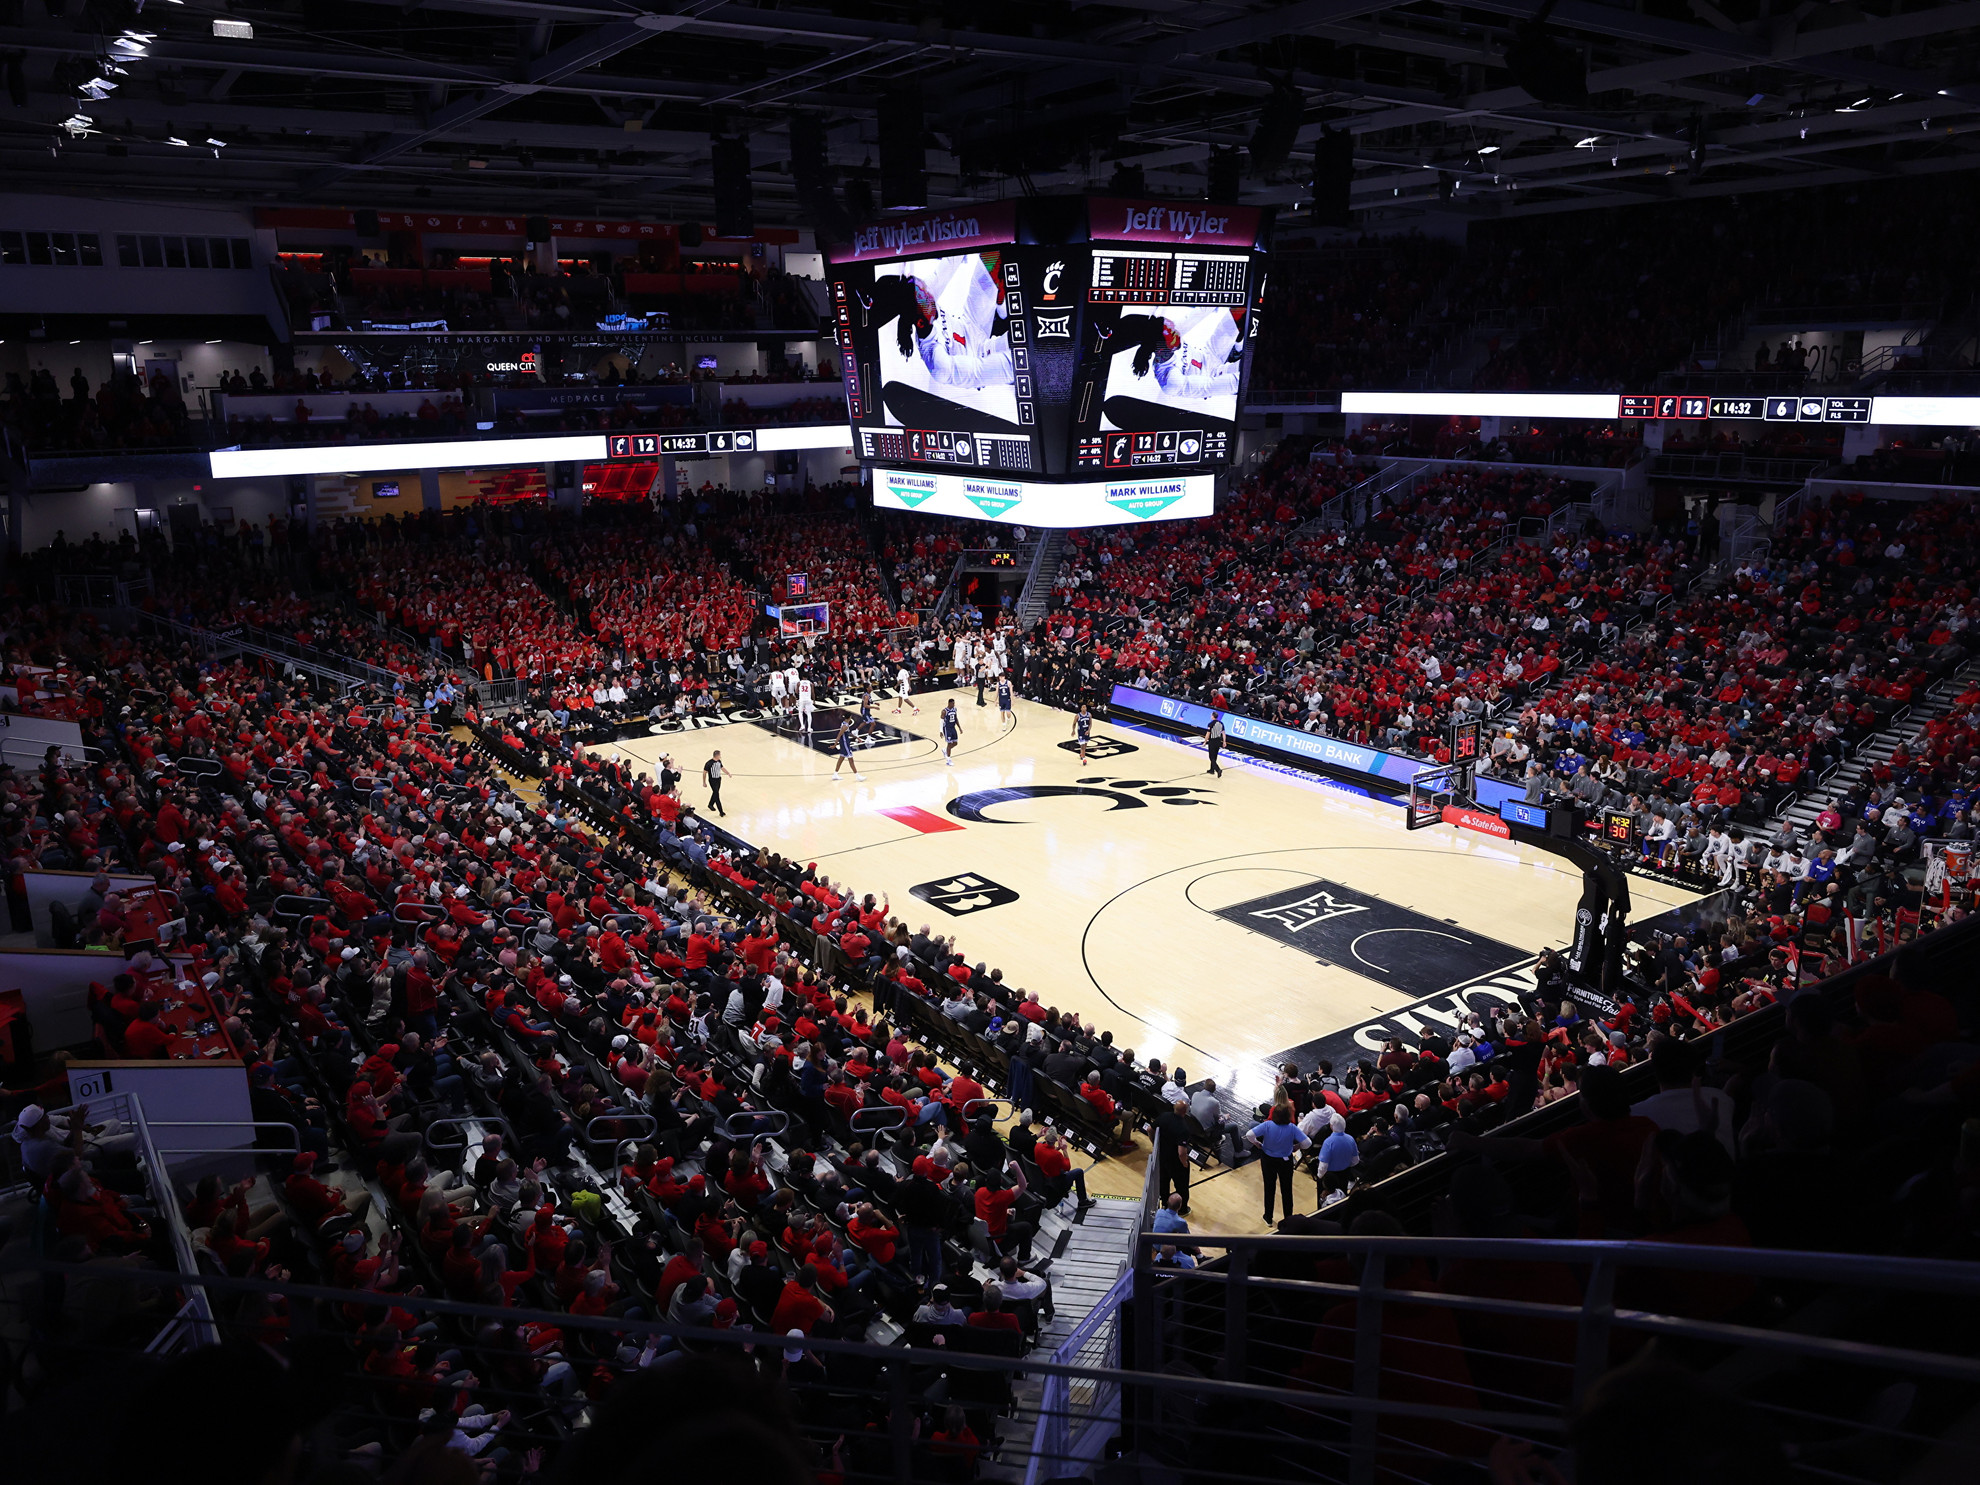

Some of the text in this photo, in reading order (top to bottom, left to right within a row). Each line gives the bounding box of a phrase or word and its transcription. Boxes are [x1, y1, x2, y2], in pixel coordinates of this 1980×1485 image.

[1123, 207, 1228, 240] Jeff Wyler
[854, 226, 880, 256] Jeff
[487, 363, 517, 371] QUEEN
[551, 394, 605, 403] MEDPACE
[1685, 401, 1702, 415] 12
[1723, 402, 1751, 414] 14:32
[1776, 402, 1786, 416] 6
[638, 439, 654, 452] 12
[672, 438, 696, 449] 14:32
[716, 436, 725, 448] 6
[926, 434, 936, 446] 12
[943, 435, 949, 446] 6
[1139, 437, 1151, 448] 12
[1163, 436, 1170, 447] 6
[889, 477, 934, 488] MARK WILLIAMS
[966, 484, 1018, 497] MARK WILLIAMS
[1110, 484, 1181, 497] MARK WILLIAMS
[792, 583, 804, 594] 30
[1251, 725, 1282, 743] FIFTH
[1286, 735, 1322, 754] THIRD
[1325, 745, 1363, 764] BANK
[1458, 737, 1474, 757] 30
[1612, 816, 1630, 828] 14:32
[1612, 826, 1626, 838] 30
[1956, 857, 1965, 865] G
[1567, 984, 1604, 1004] FURNITURE
